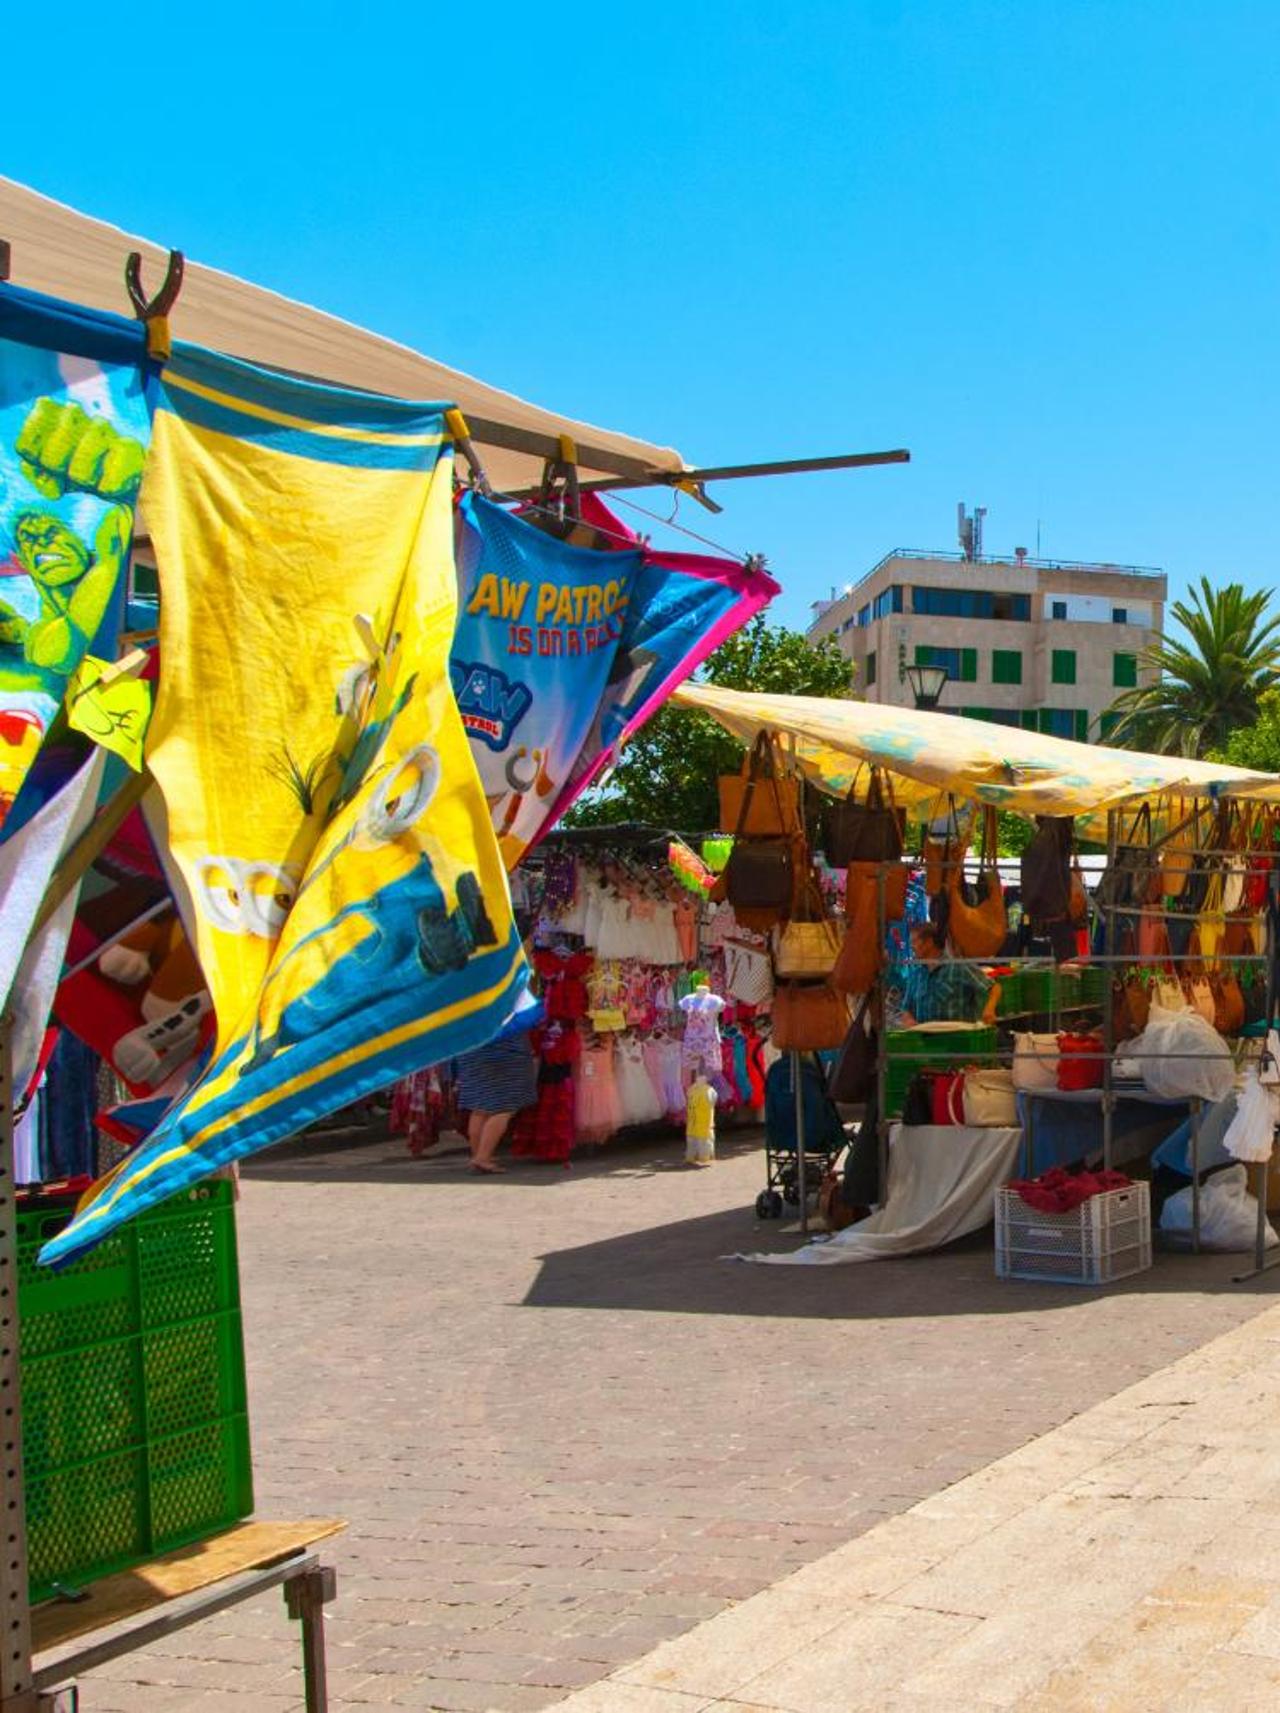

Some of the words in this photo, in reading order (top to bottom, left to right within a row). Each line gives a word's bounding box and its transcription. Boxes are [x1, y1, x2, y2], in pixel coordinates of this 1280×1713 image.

[467, 573, 531, 622] AW
[507, 625, 533, 656] IS
[567, 629, 581, 656] A
